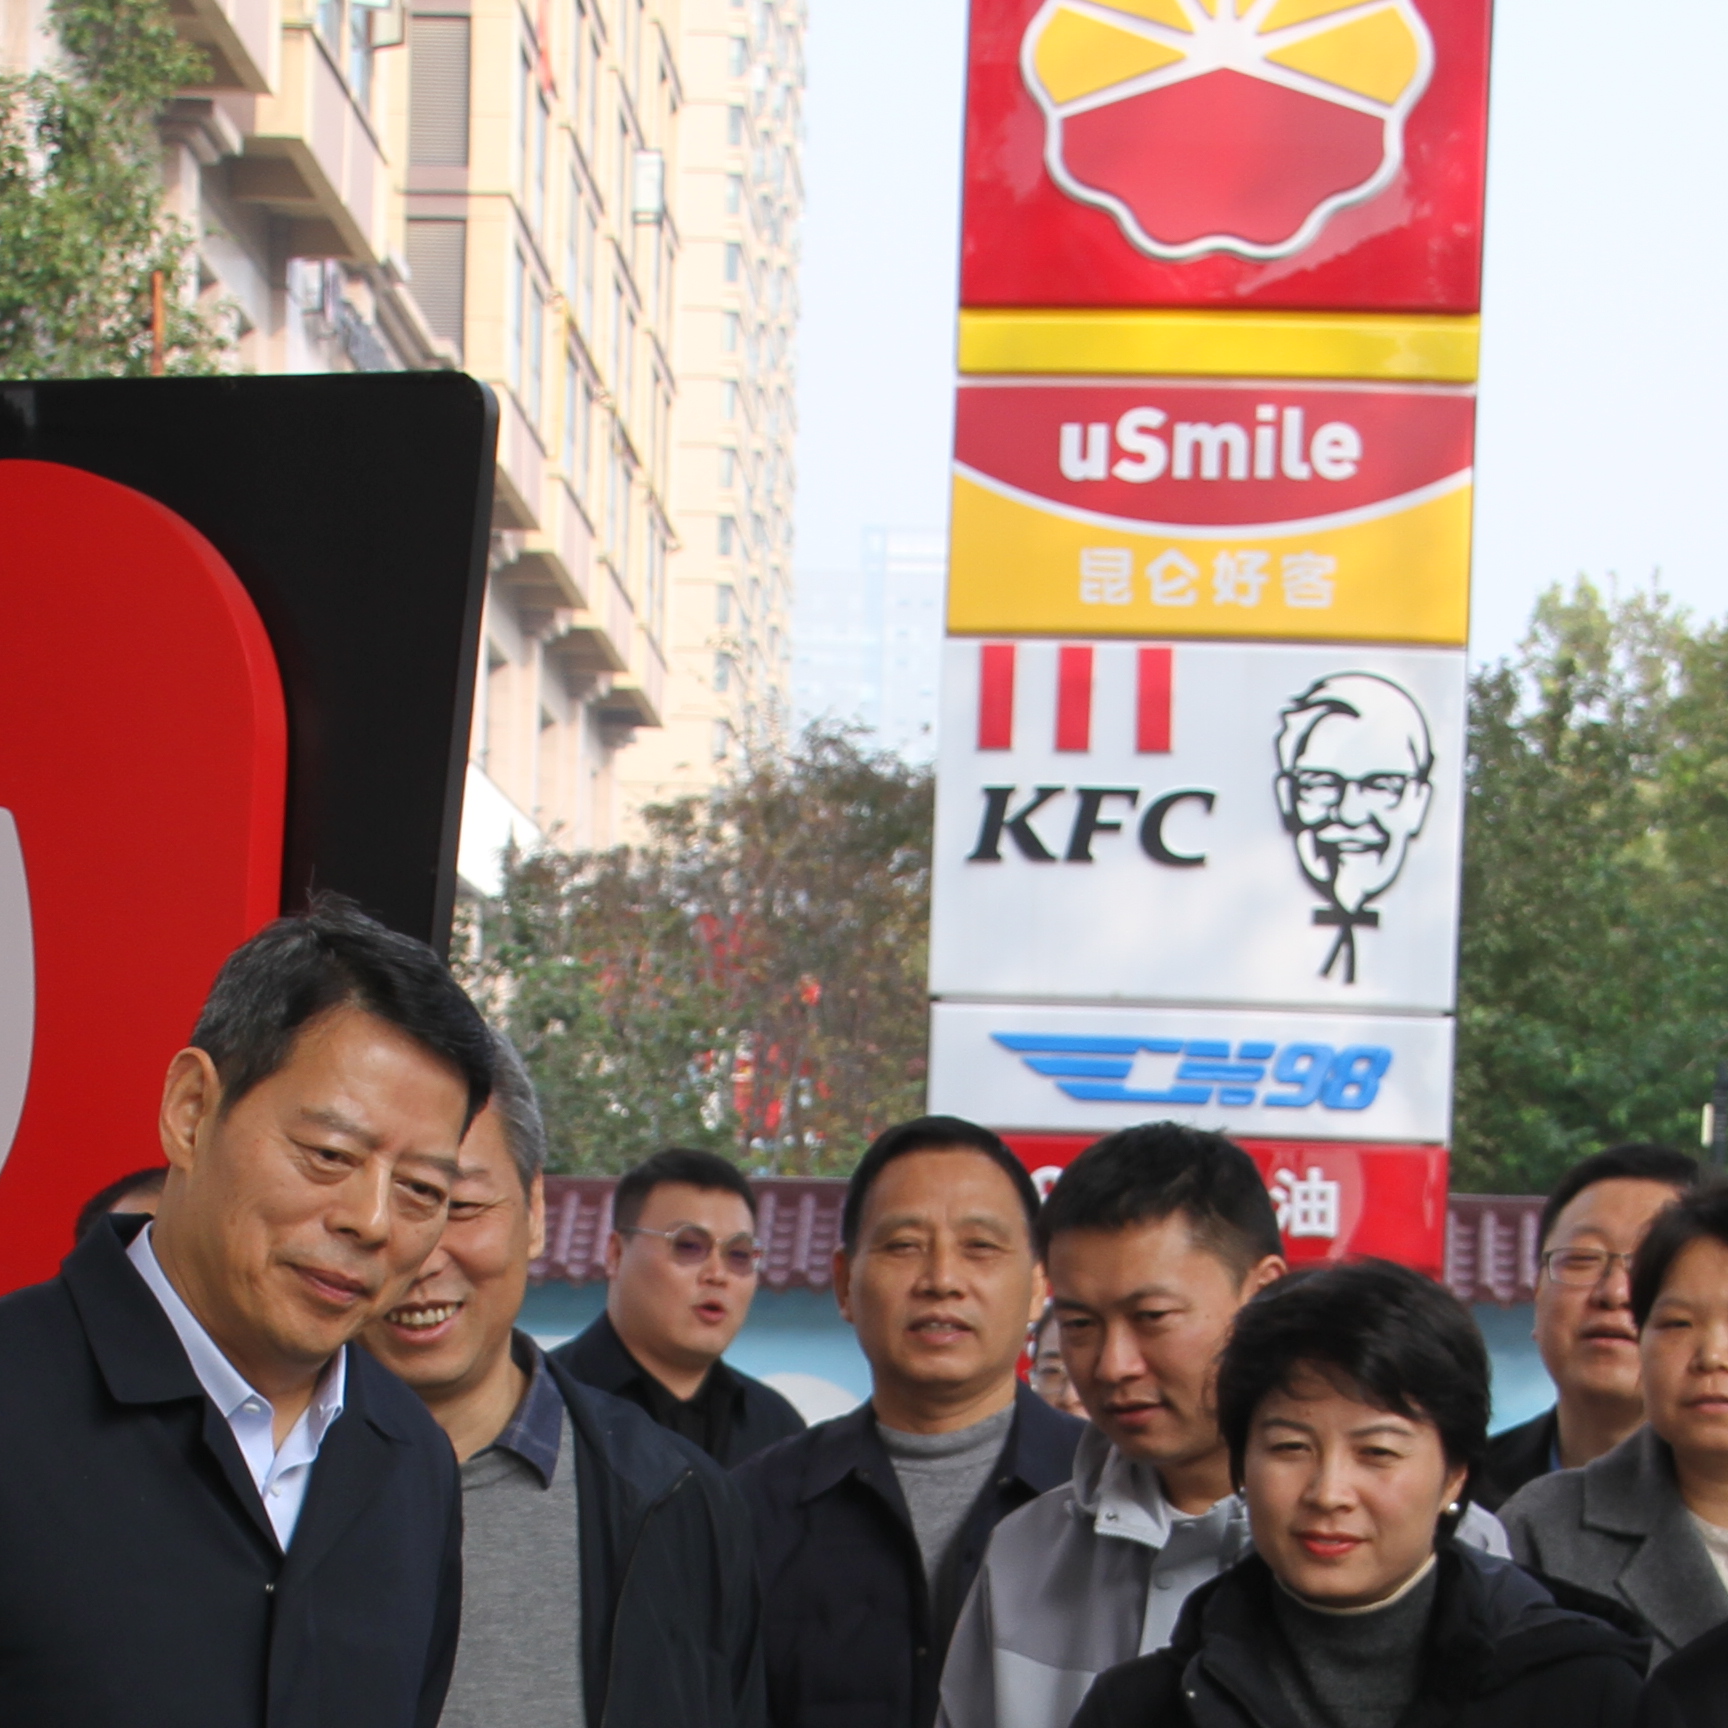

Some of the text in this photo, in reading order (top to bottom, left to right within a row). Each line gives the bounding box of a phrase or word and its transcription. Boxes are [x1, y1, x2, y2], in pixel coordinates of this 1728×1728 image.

[1059, 405, 1362, 482] uSmile
[1080, 548, 1337, 609] 昆仑好客
[965, 784, 1218, 867] KFC
